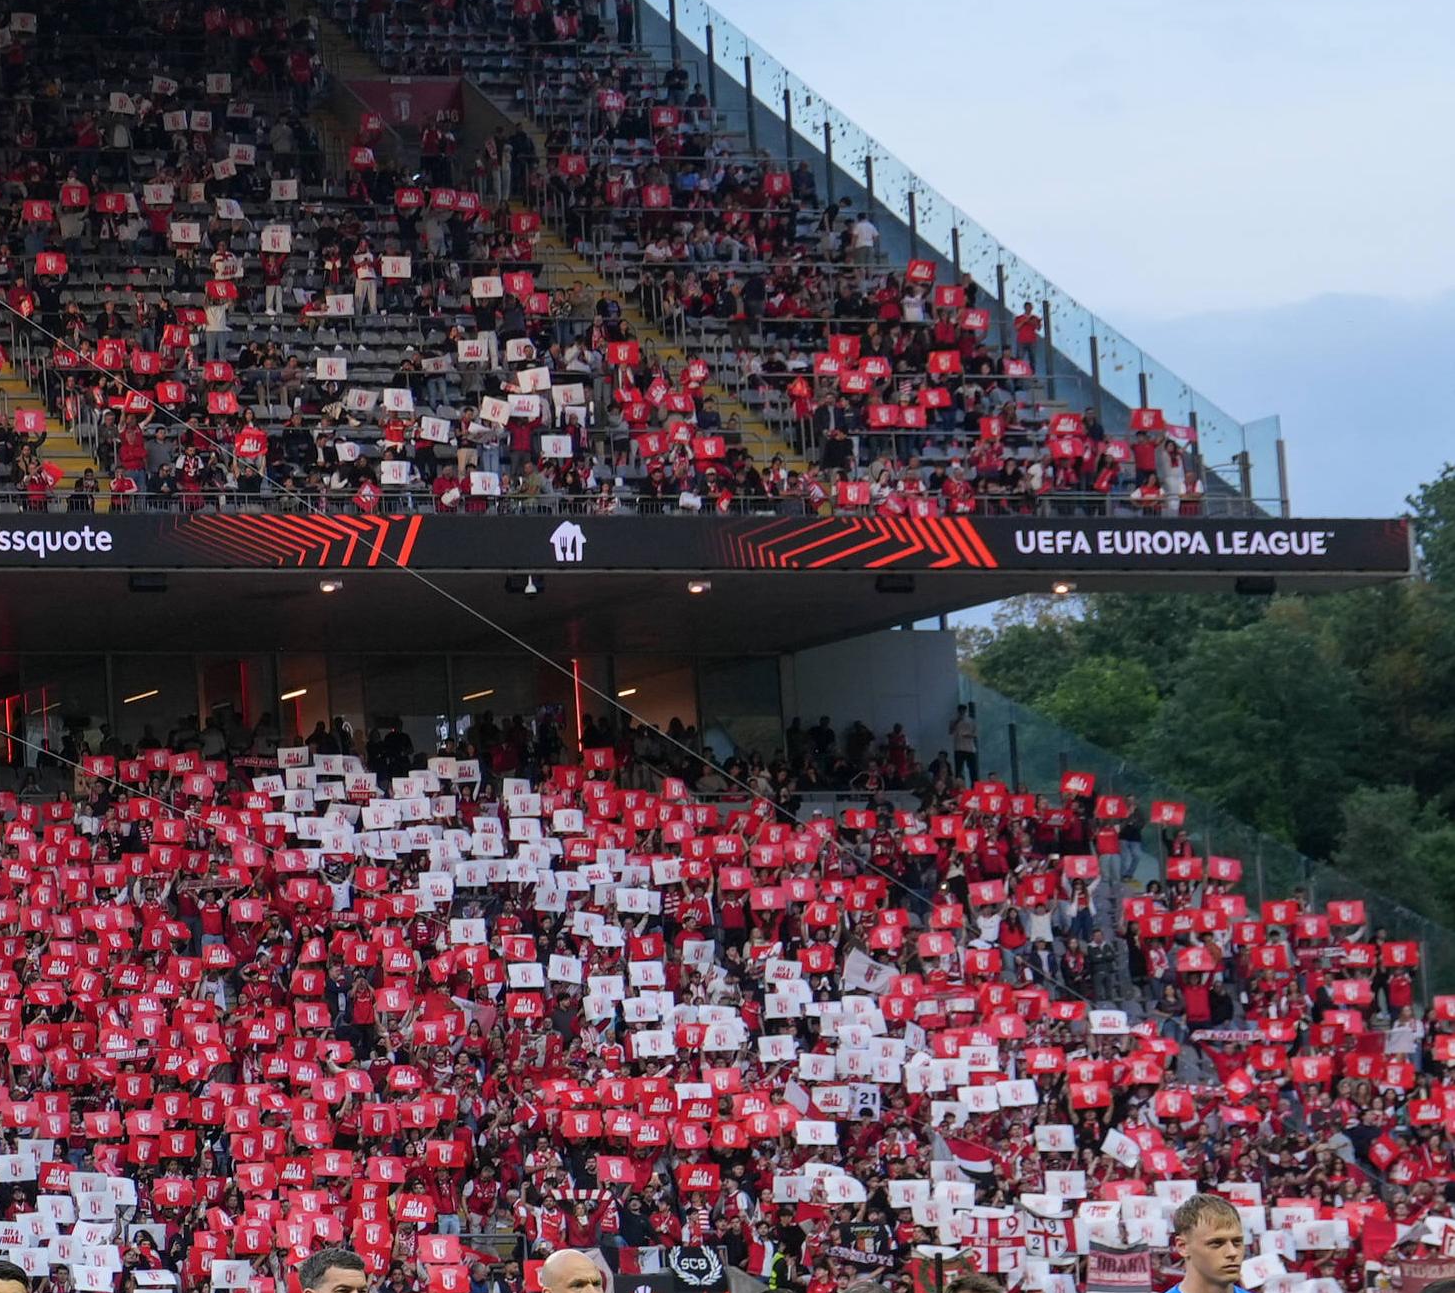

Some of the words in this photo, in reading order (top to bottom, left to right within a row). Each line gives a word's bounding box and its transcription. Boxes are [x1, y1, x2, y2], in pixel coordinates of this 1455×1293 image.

[1016, 530, 1091, 555] UEFA
[1099, 531, 1208, 555] EUROPA
[860, 1092, 877, 1105] 21
[681, 1257, 708, 1270] SCB
